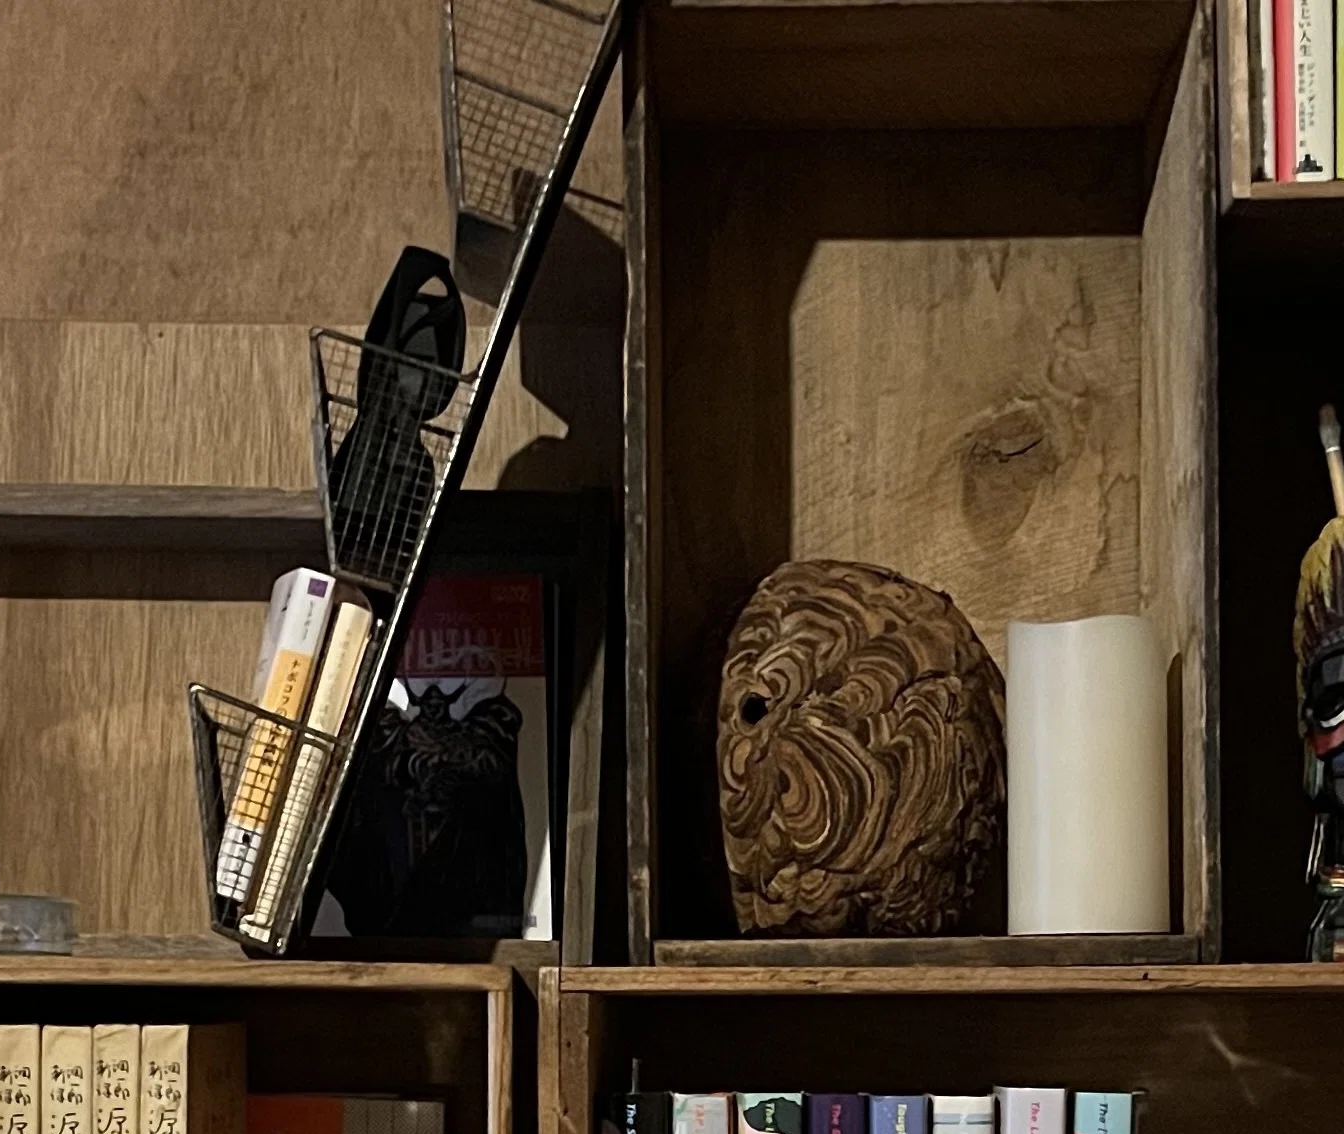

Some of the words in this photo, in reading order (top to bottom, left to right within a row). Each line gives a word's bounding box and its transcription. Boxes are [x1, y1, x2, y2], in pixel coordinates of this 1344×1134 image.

[626, 1104, 637, 1125] The
[1030, 1101, 1041, 1123] The
[1098, 1103, 1109, 1124] The
